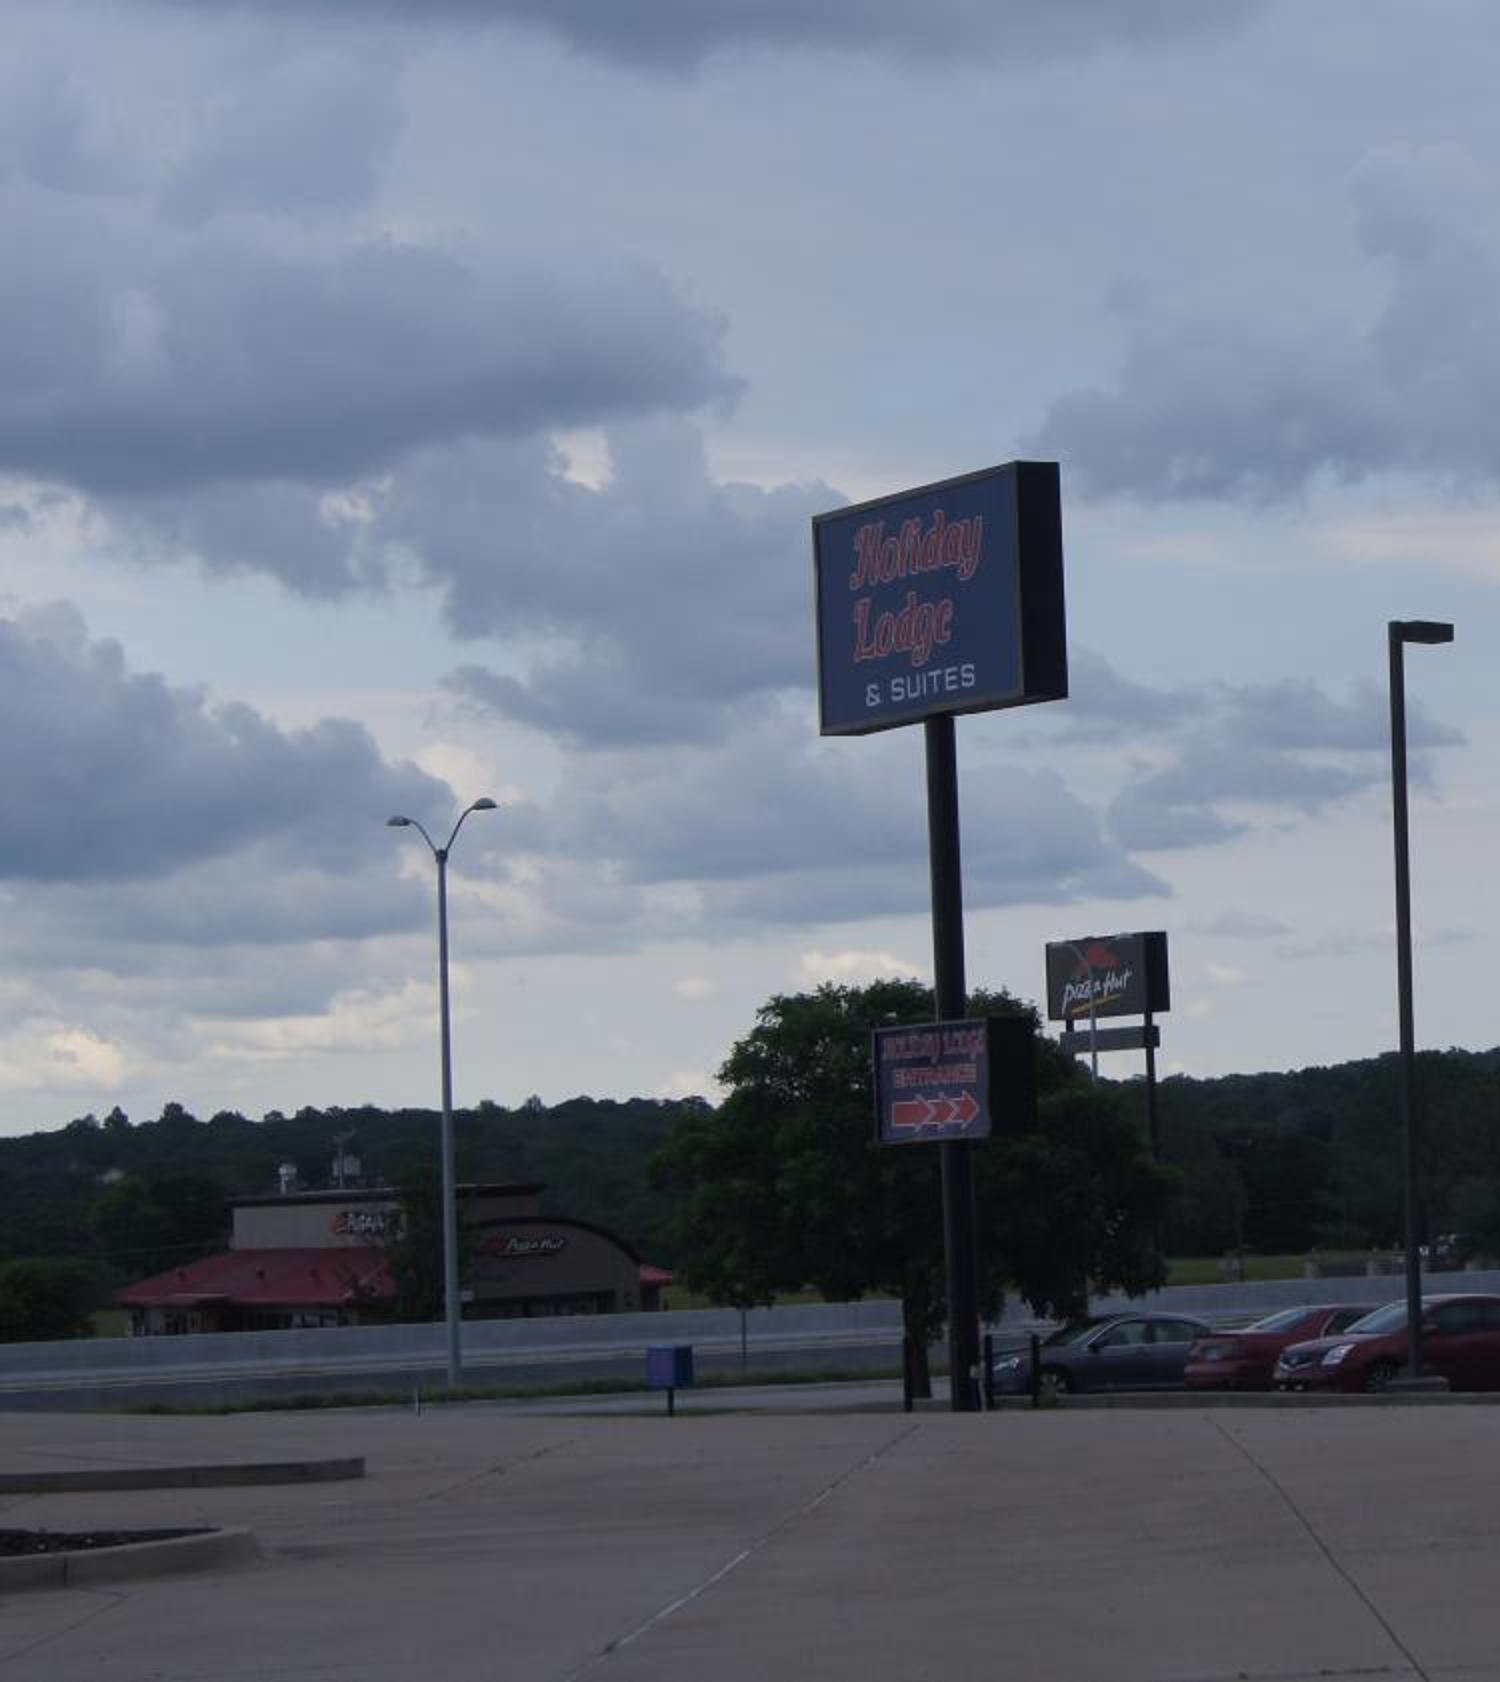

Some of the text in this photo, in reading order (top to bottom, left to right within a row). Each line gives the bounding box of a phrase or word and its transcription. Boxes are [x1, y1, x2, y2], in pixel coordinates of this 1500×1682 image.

[849, 509, 983, 590] Holiday
[853, 592, 953, 667] Lodge
[865, 664, 976, 707] & SUITES
